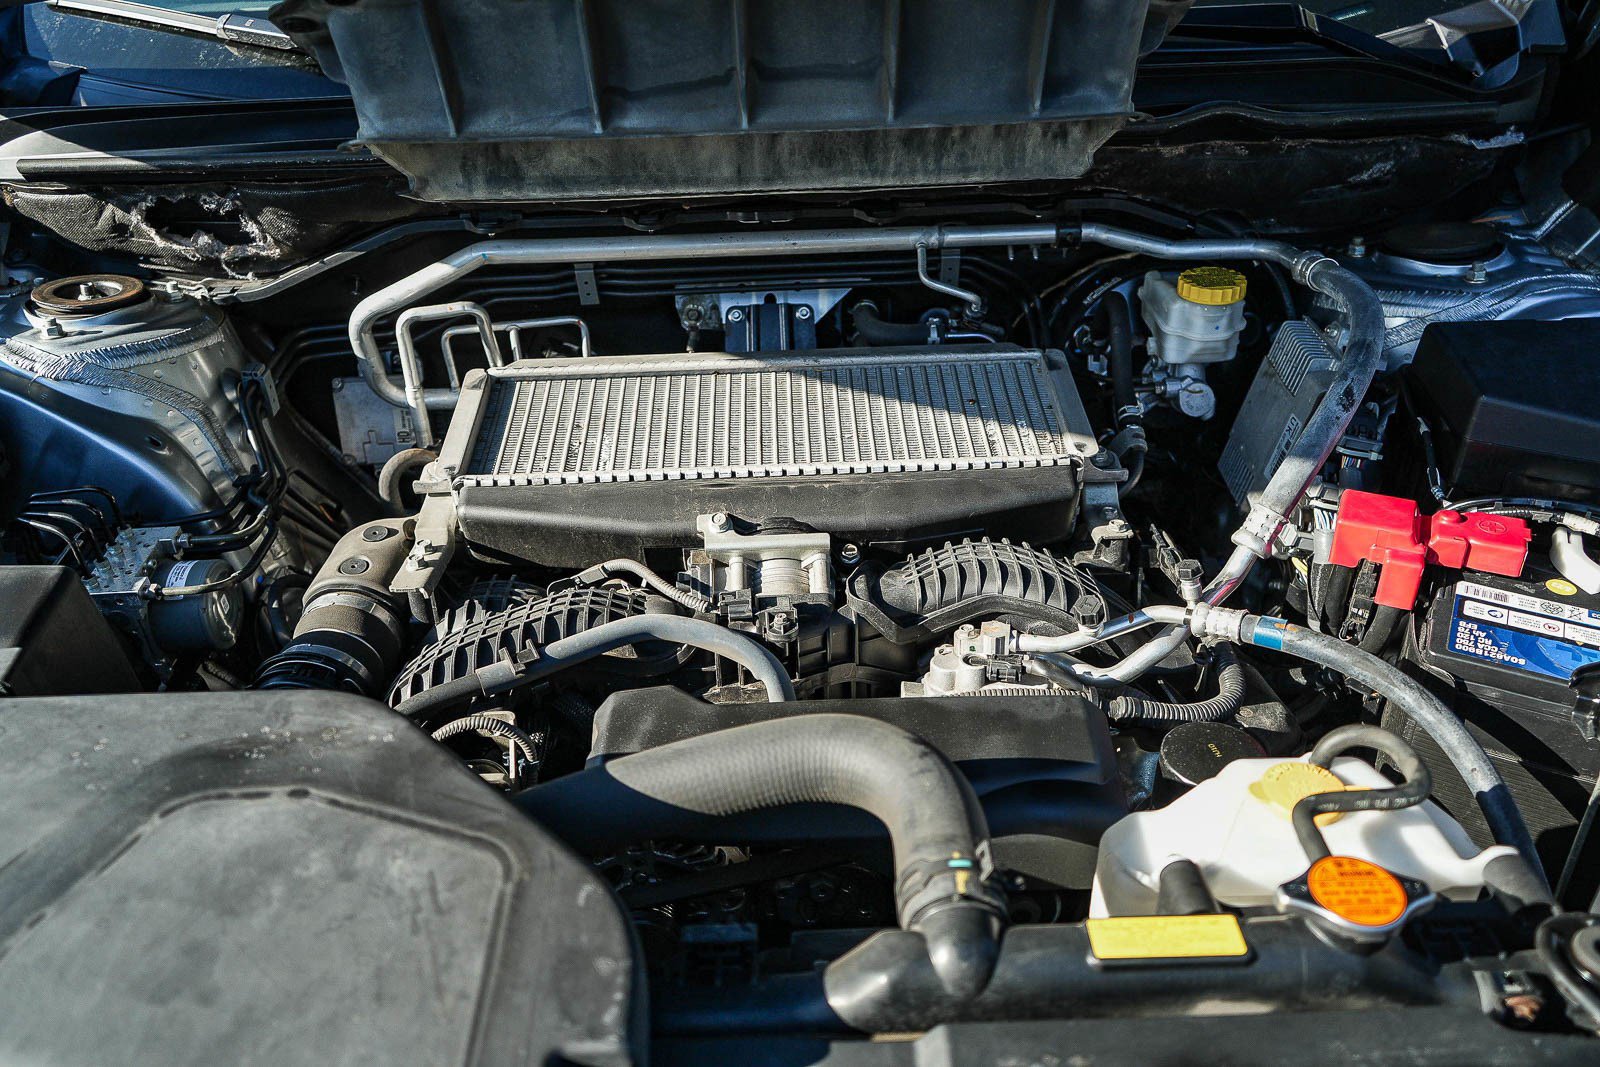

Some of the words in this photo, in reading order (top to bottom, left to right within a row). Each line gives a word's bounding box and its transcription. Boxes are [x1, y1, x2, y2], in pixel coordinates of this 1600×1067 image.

[1456, 632, 1476, 641] 120
[1477, 637, 1493, 646] RC
[1477, 642, 1499, 652] CCA
